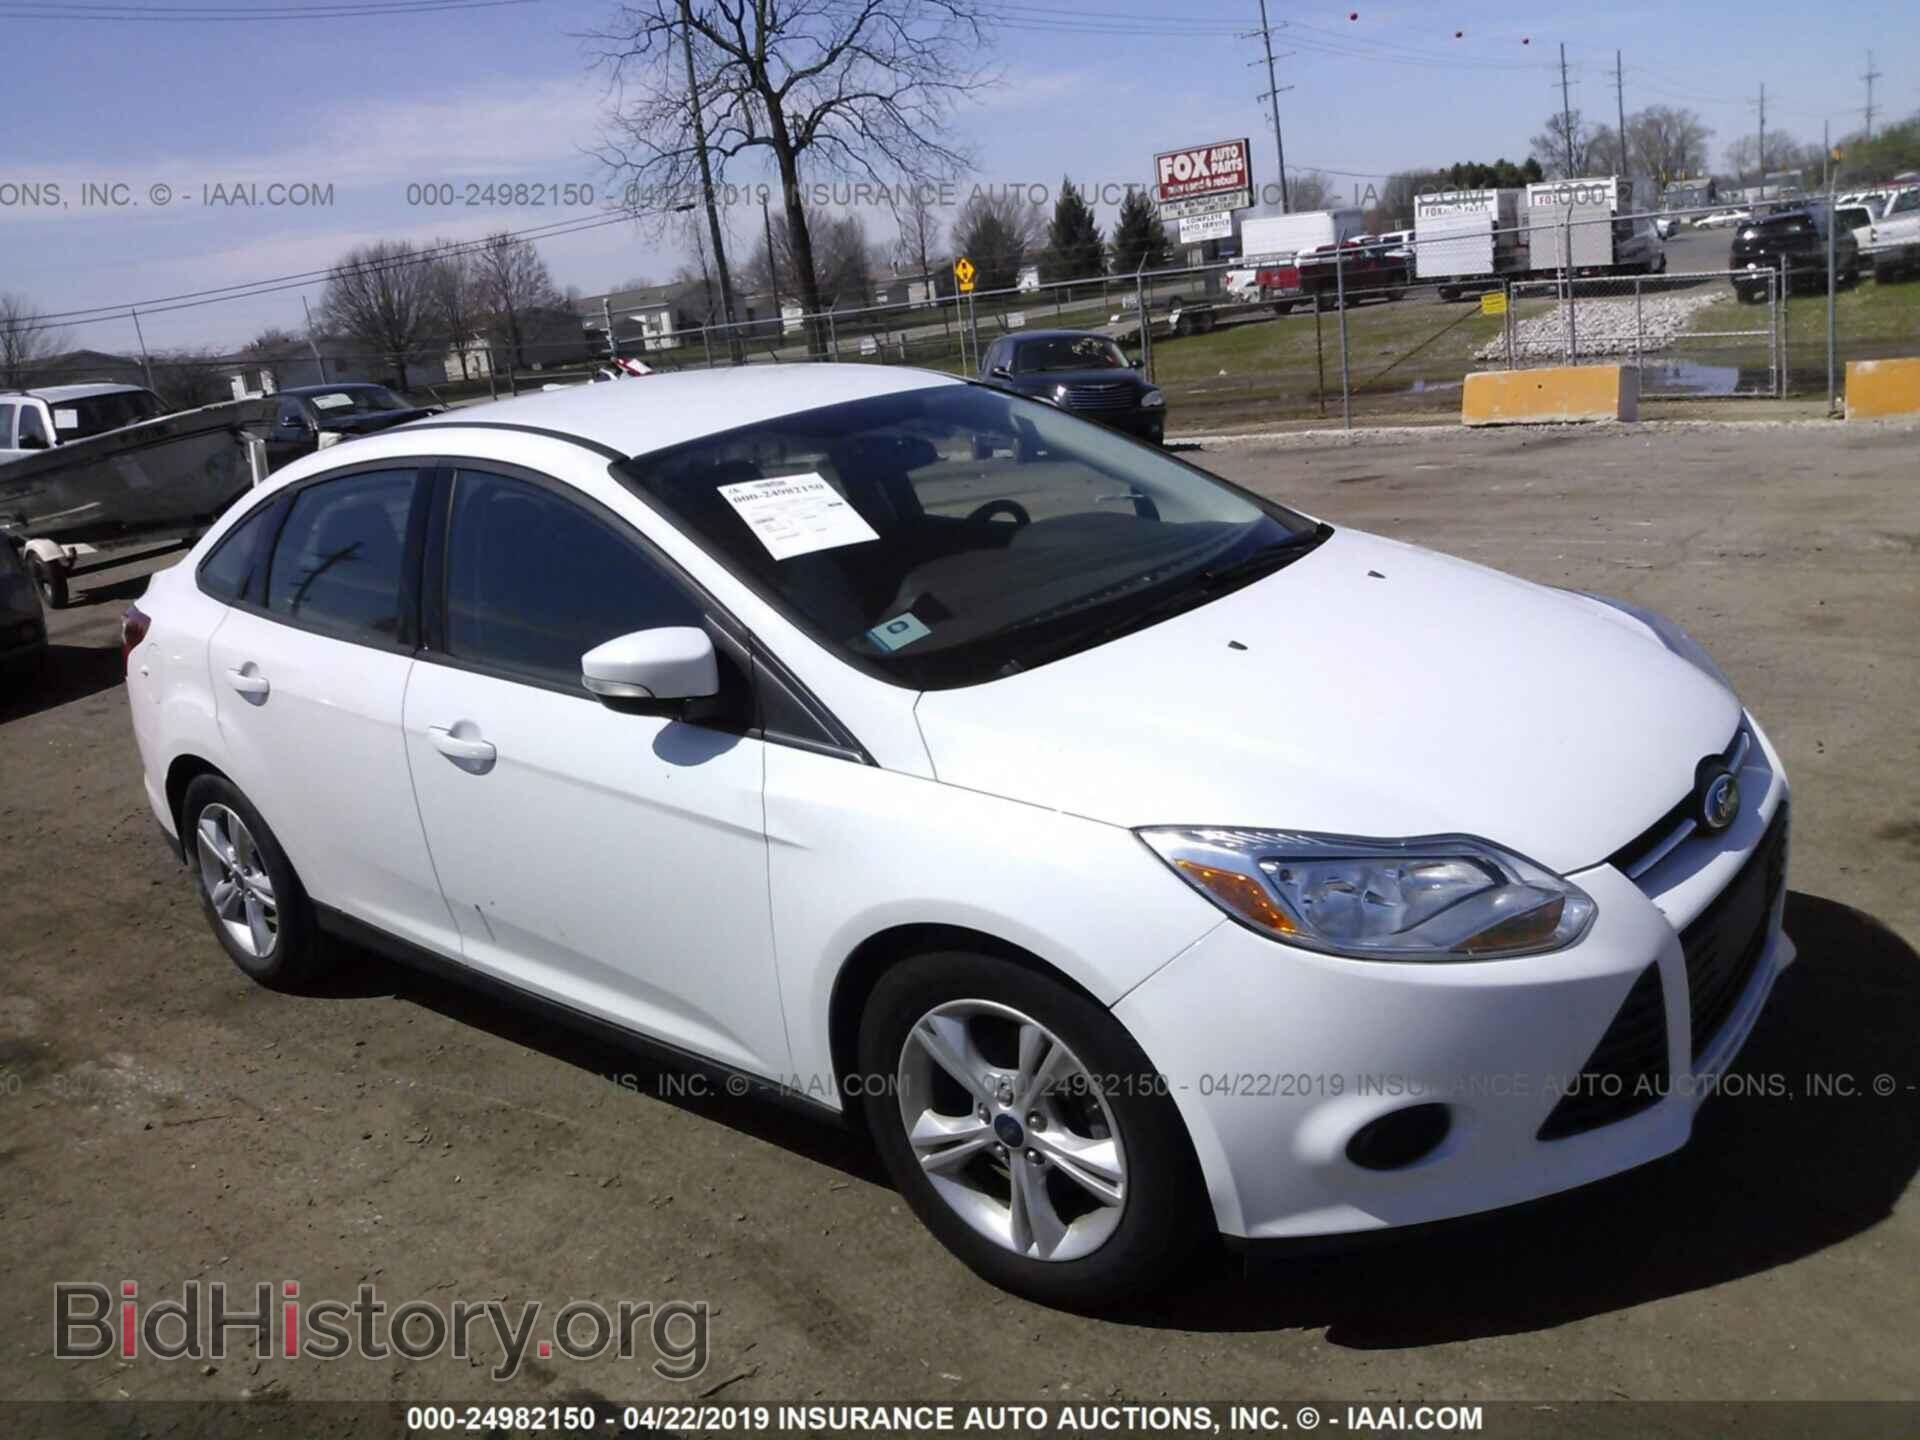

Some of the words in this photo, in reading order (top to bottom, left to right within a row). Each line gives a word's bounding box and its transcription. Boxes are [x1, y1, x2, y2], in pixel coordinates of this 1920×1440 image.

[1211, 146, 1239, 161] AUTO
[1160, 151, 1210, 184] FOX
[1211, 158, 1243, 174] PARTS
